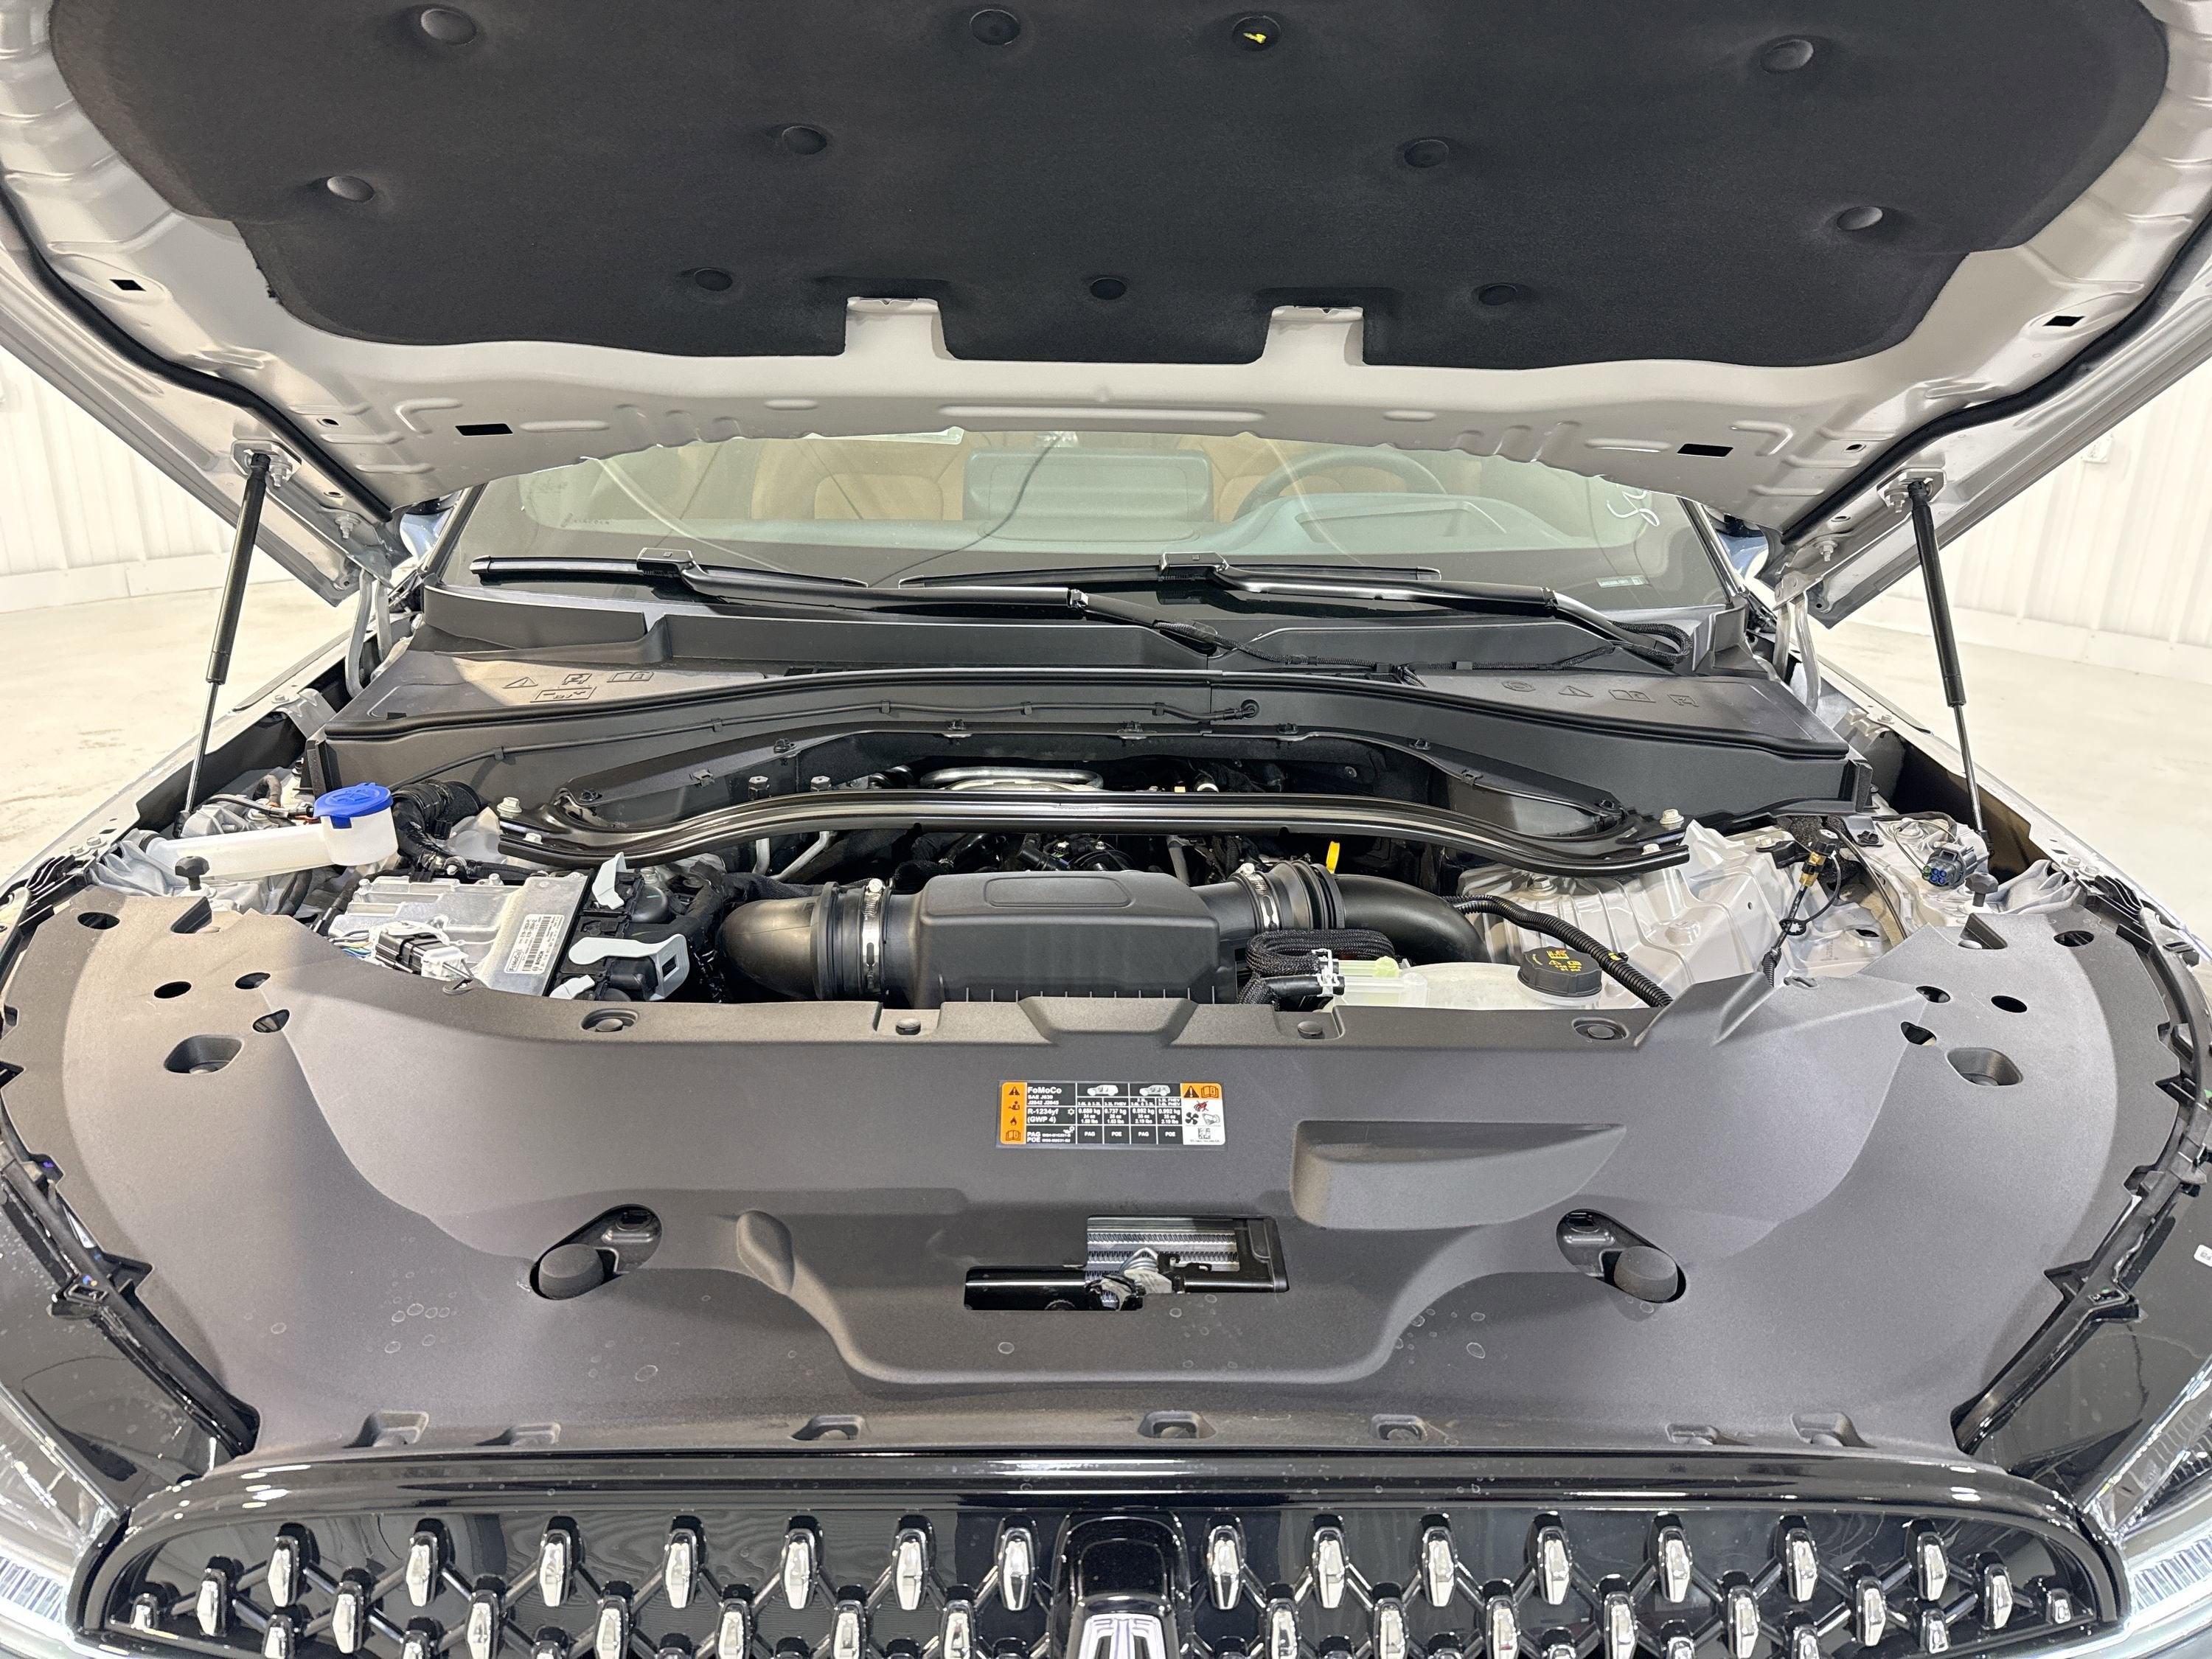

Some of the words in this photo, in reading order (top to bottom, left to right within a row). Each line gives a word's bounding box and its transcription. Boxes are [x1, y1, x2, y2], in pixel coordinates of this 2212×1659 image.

[535, 951, 544, 965] BOSCH
[1027, 1086, 1062, 1094] FoMoCo
[1027, 1108, 1059, 1116] R-1234yf
[1027, 1116, 1048, 1124] (GWP
[1048, 1116, 1057, 1124] 4)
